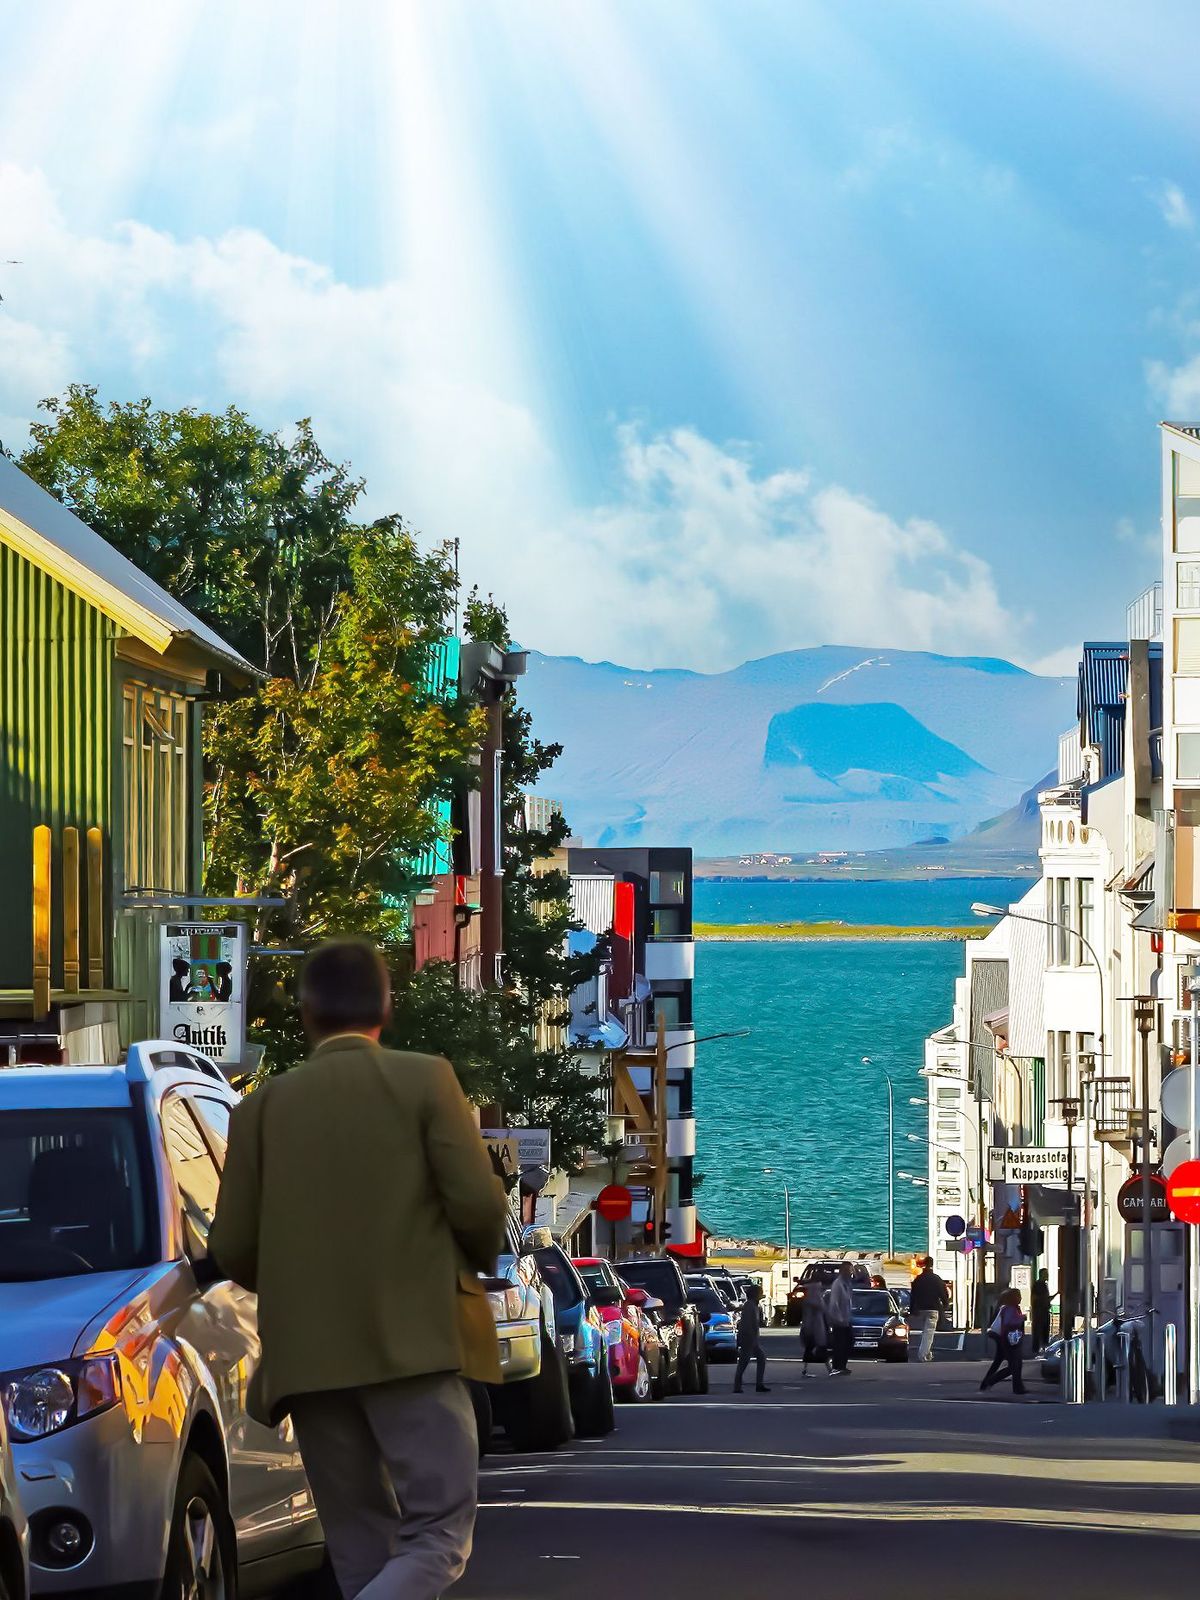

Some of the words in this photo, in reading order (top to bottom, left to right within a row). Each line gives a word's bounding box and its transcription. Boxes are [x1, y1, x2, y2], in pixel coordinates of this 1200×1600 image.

[173, 1023, 226, 1045] Antik
[1007, 1151, 1067, 1163] Rakarastofa
[1123, 1198, 1166, 1207] CAMARI
